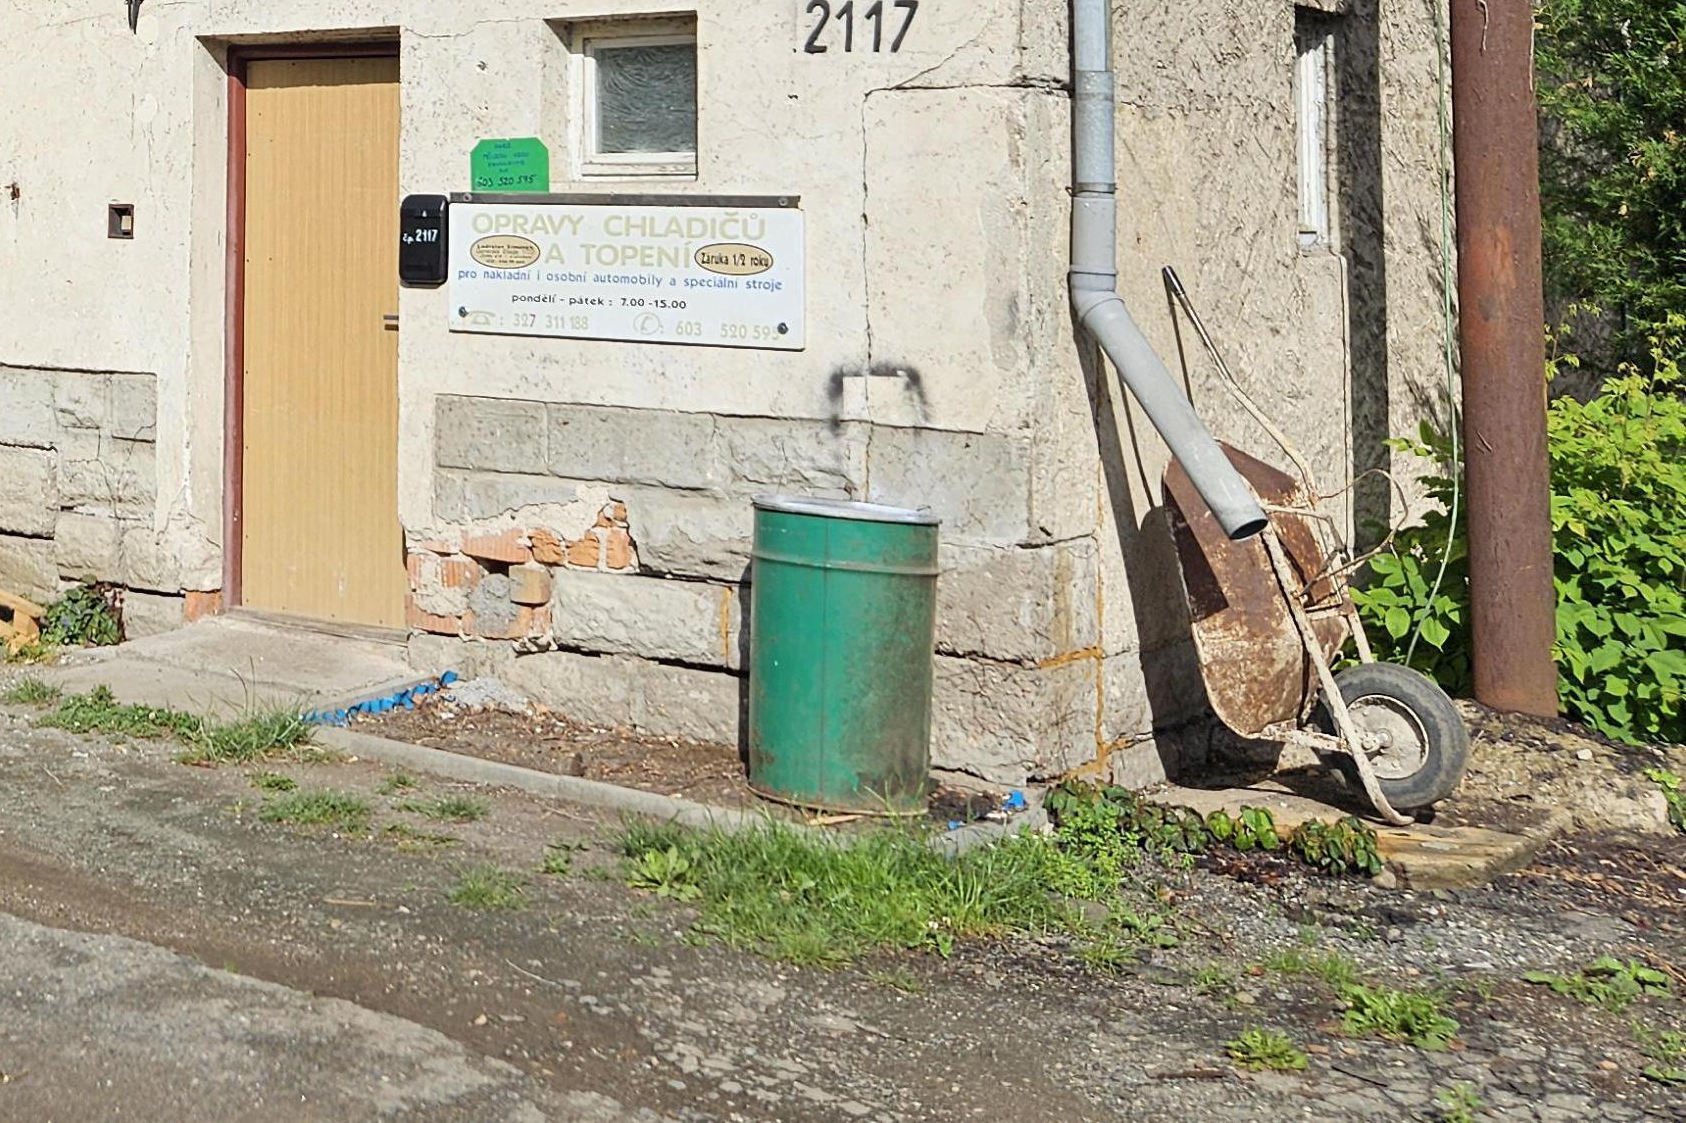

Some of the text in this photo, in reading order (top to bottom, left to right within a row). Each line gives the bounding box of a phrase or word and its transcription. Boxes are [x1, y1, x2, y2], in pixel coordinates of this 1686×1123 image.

[415, 228, 438, 243] 2117
[472, 211, 766, 240] OPRAVY CHLADIČŮ
[544, 240, 693, 269] A TOPENÍ
[750, 254, 769, 268] roku
[458, 269, 477, 281] pro
[546, 271, 587, 283] osobní
[593, 273, 663, 288] automobily
[669, 278, 677, 286] a
[745, 279, 783, 293] stroje
[511, 293, 557, 304] pondělí
[620, 297, 645, 307] 7.00
[513, 313, 537, 328] 327
[545, 314, 565, 329] 311
[675, 320, 702, 336] 603
[720, 324, 747, 339] 520
